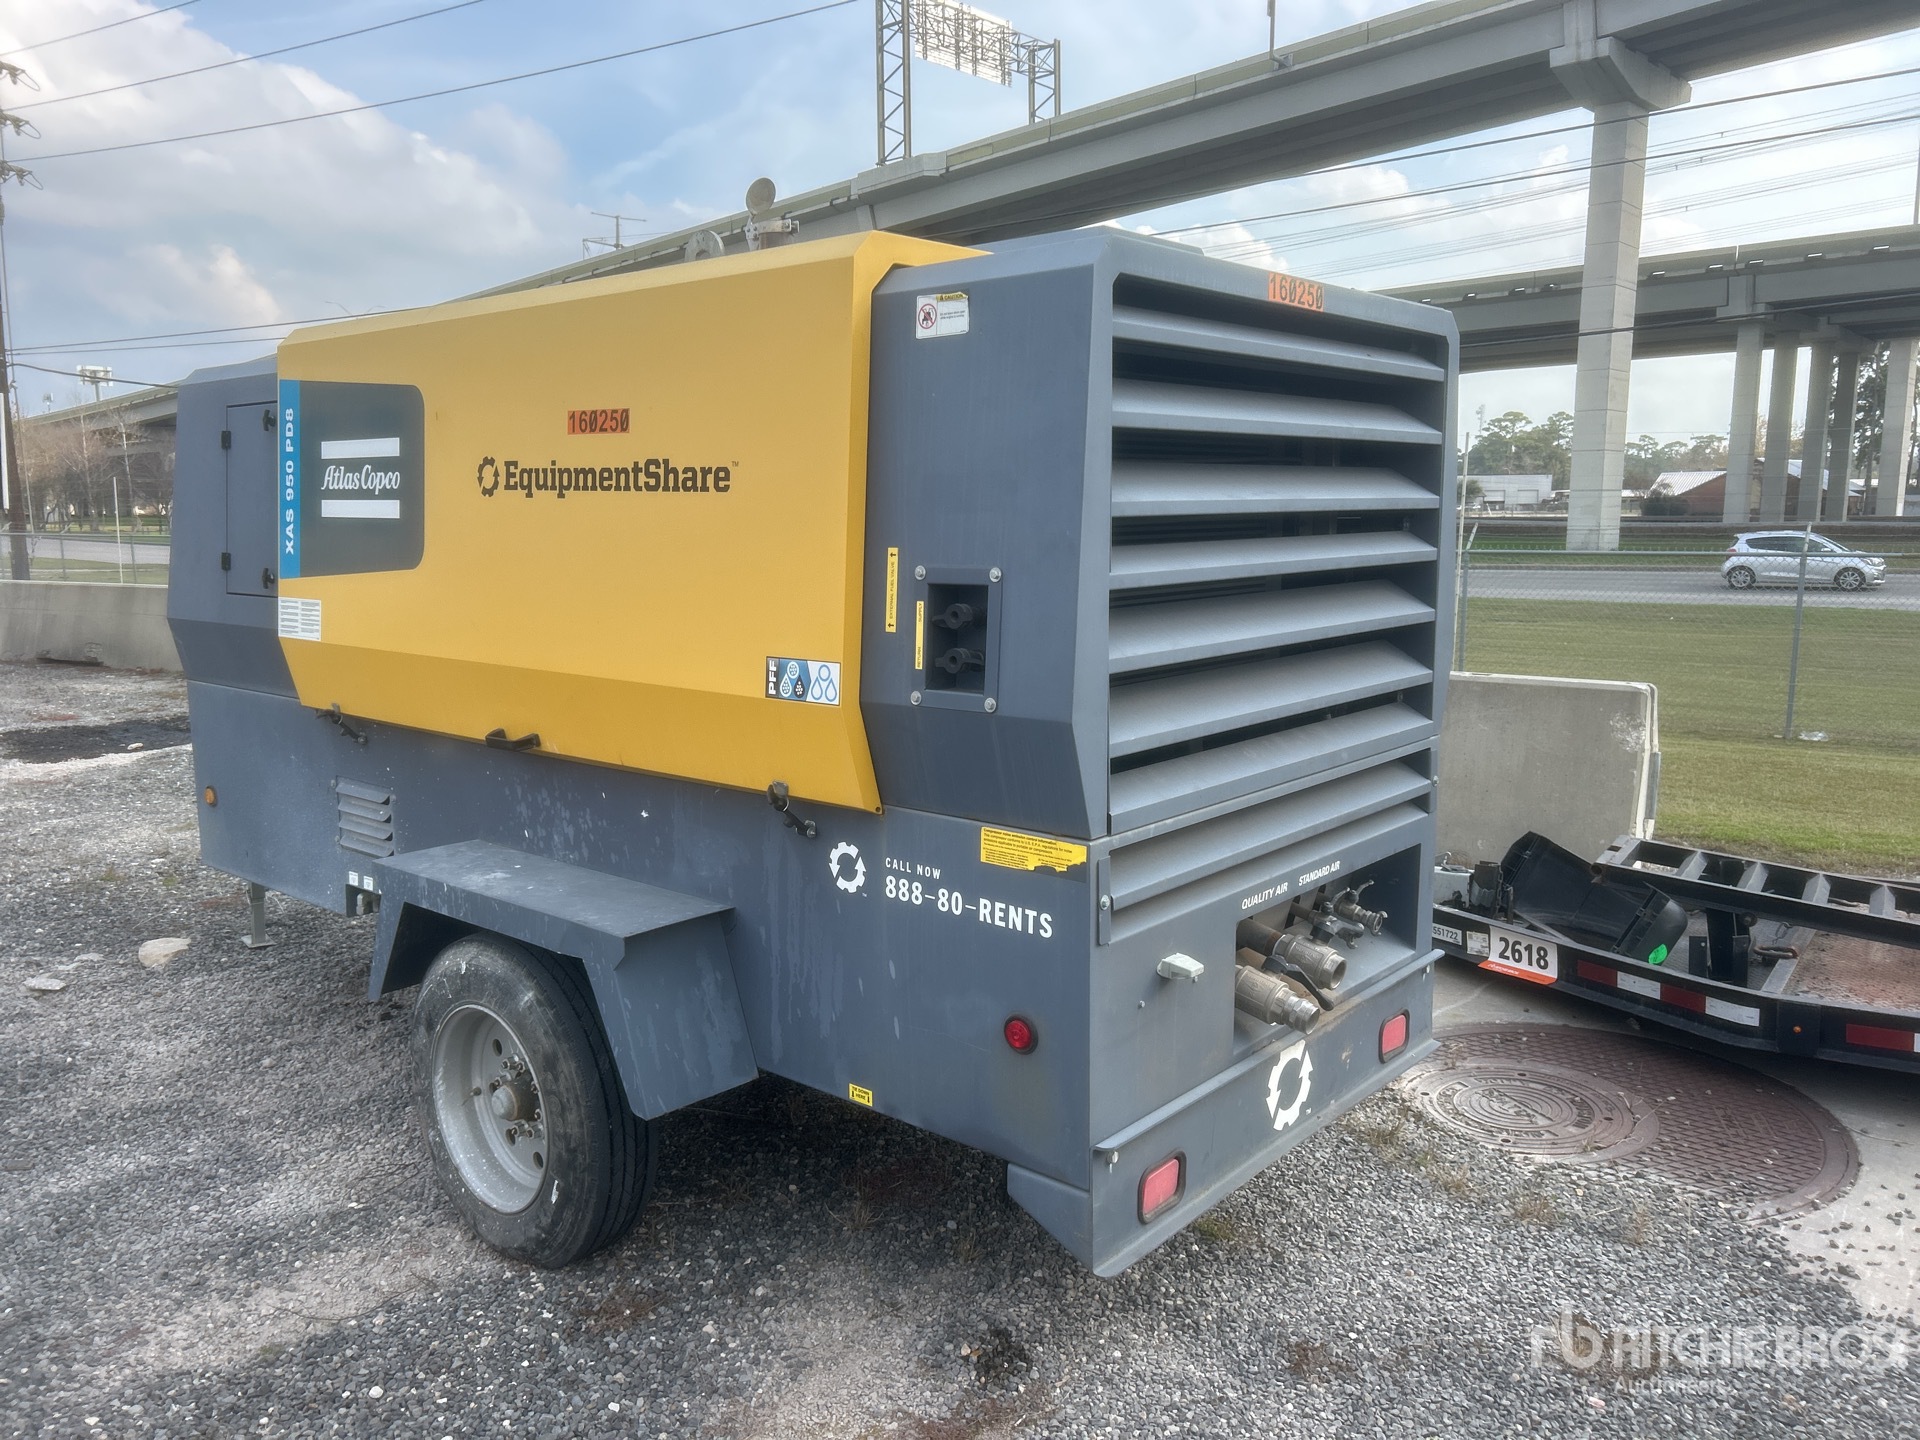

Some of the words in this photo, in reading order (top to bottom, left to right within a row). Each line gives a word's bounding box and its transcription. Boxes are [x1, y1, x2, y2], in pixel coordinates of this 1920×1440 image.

[1270, 273, 1323, 310] 160250
[285, 408, 294, 452] PD8
[568, 408, 630, 434] 160250
[285, 460, 294, 501] 950
[321, 464, 360, 490] Atlas
[360, 464, 400, 495] Copco
[503, 458, 731, 499] EquipmentShare
[285, 508, 294, 555] XAS
[768, 660, 776, 695] PFF
[885, 857, 912, 873] CALL
[917, 864, 941, 880] NOW
[1298, 865, 1330, 887] STANDARD
[1330, 860, 1340, 873] AIR
[885, 875, 1053, 939] 888-80-RENTS
[1241, 887, 1275, 910] QUALITY
[1275, 881, 1289, 897] AIR
[1433, 926, 1458, 941] 551722
[1498, 936, 1549, 970] 2618
